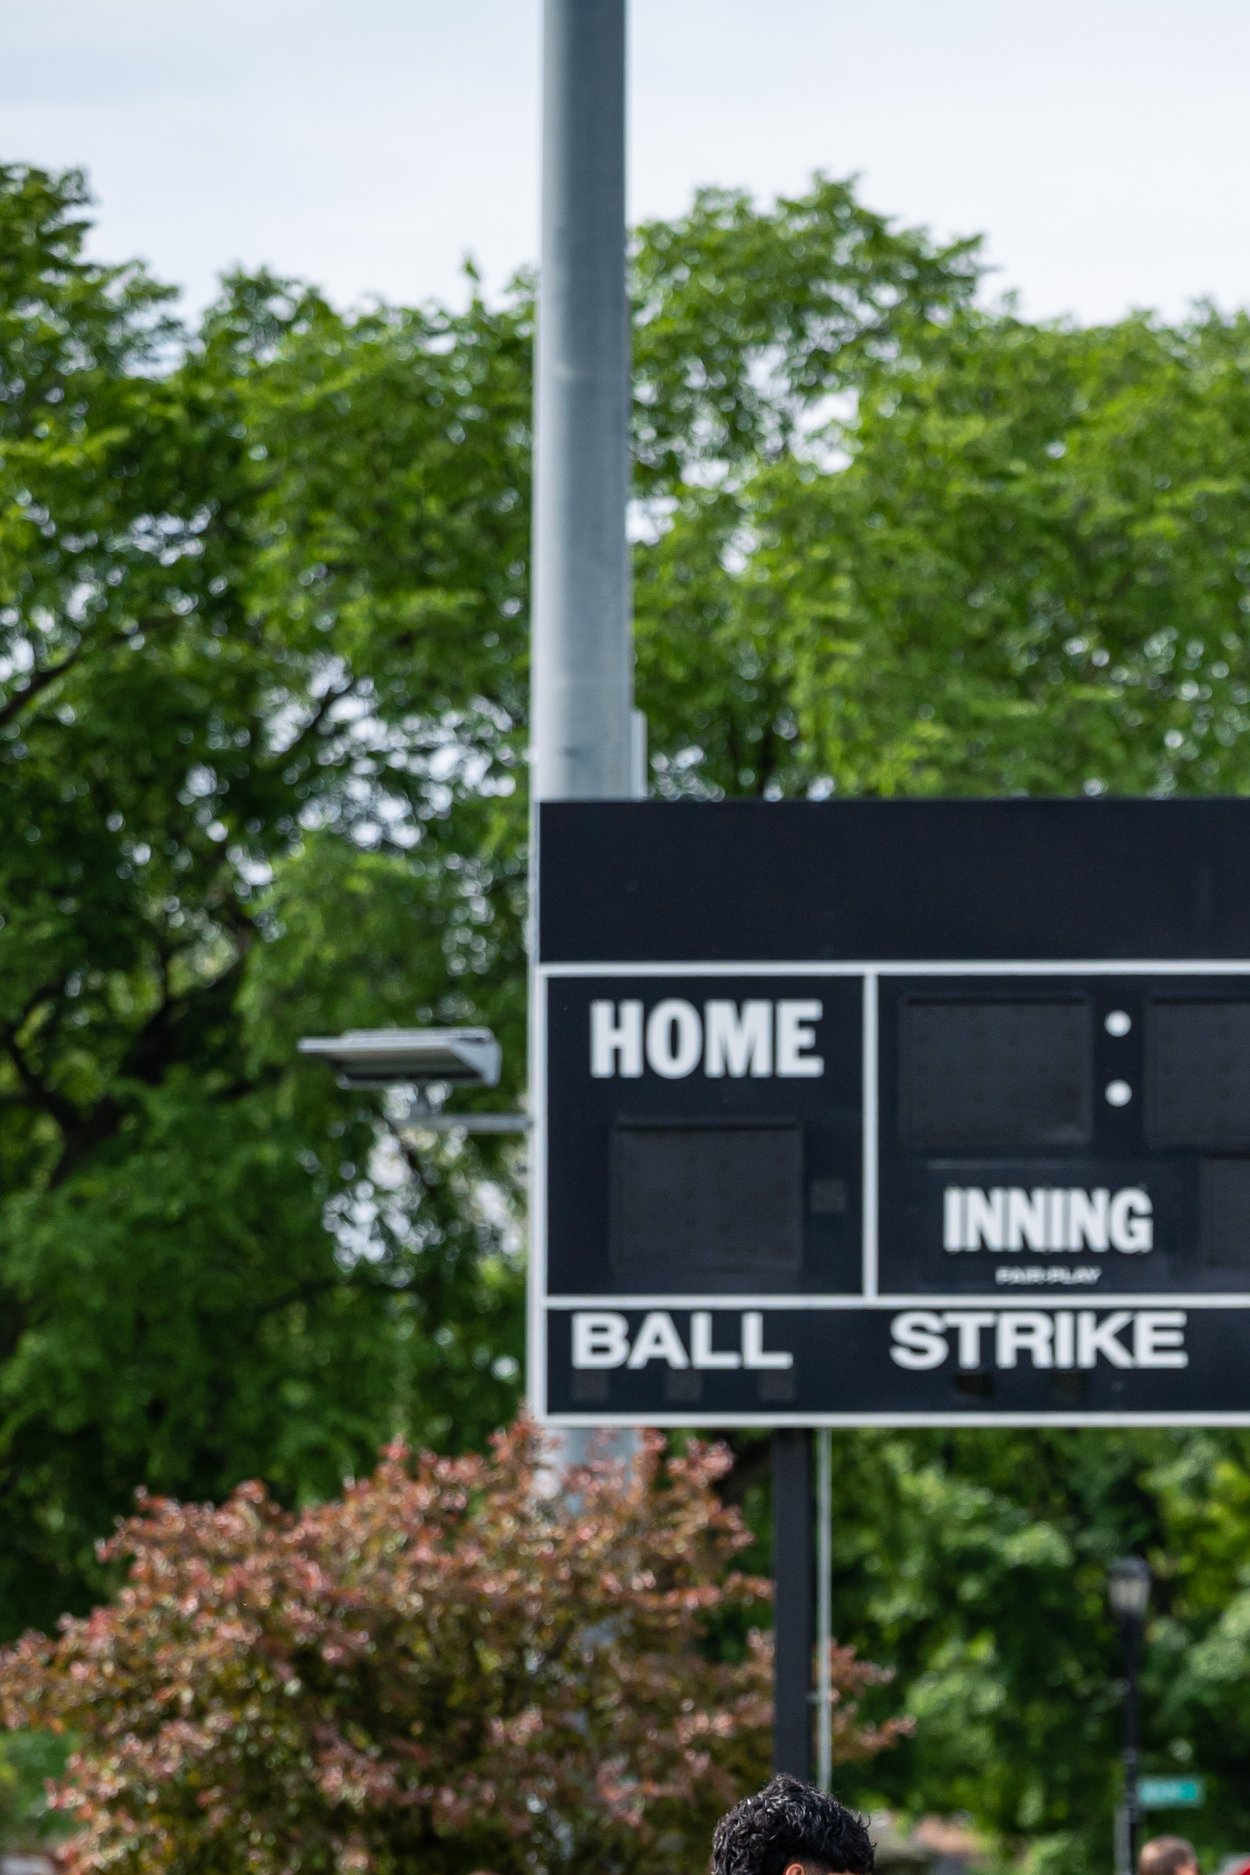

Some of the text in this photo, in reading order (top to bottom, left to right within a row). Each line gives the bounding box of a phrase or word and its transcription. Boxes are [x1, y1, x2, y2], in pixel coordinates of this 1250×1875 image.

[590, 999, 824, 1079] HOME
[943, 1187, 1153, 1254] INNING
[571, 1310, 795, 1370] BALL
[890, 1310, 1189, 1370] STRIKE
